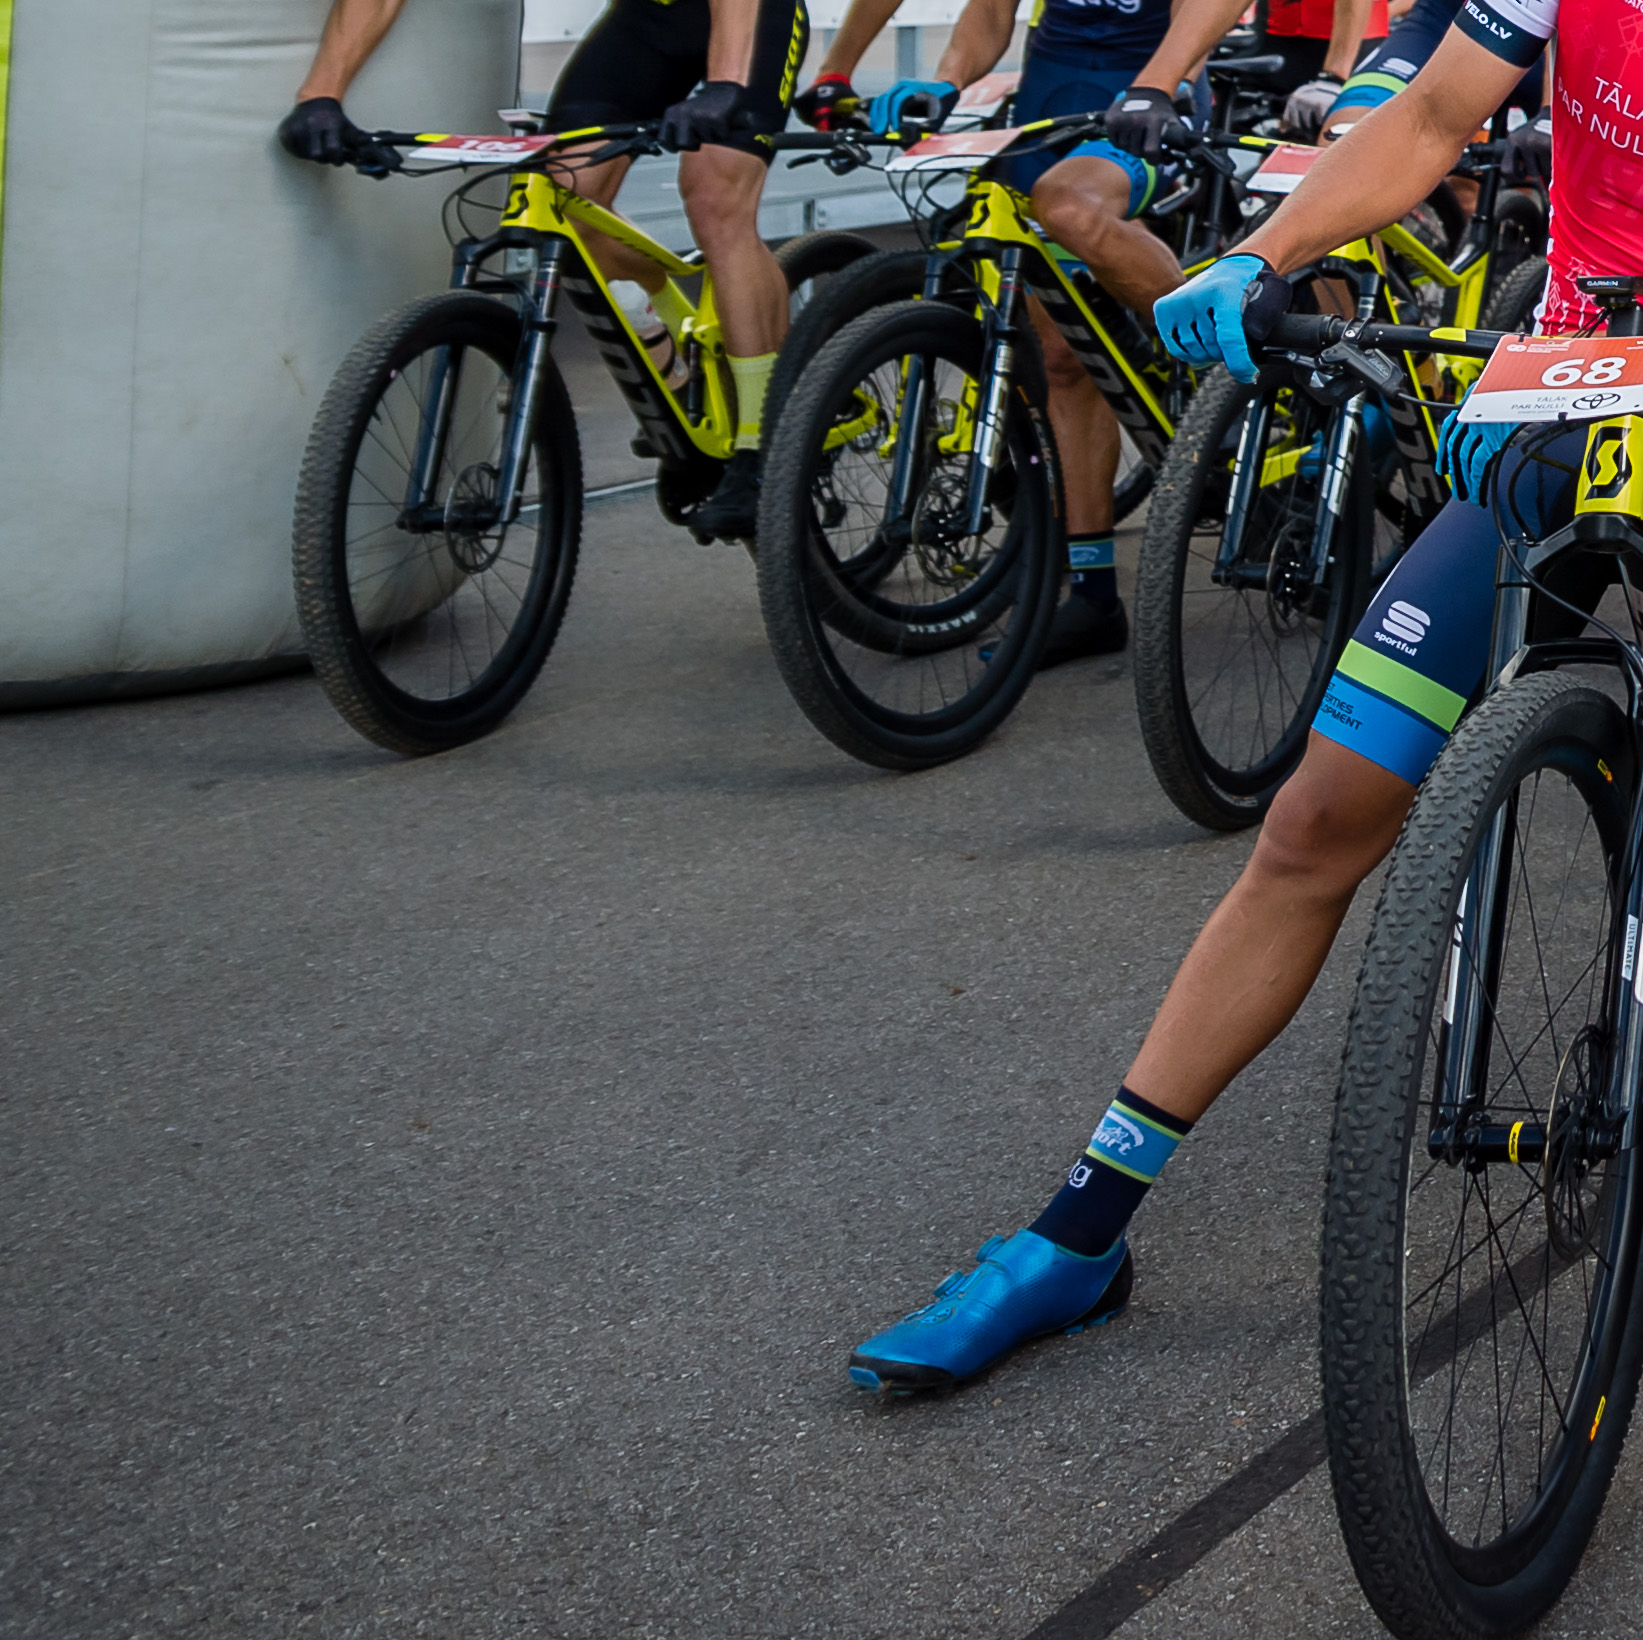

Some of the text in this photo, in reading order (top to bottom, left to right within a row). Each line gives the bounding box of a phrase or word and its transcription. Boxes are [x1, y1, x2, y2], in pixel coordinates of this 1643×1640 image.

[1464, 0, 1513, 40] VELO.LV
[1586, 279, 1620, 288] GARMIN
[1540, 356, 1628, 388] 68
[1373, 631, 1418, 657] sportful
[1624, 922, 1637, 970] ULTIMATE
